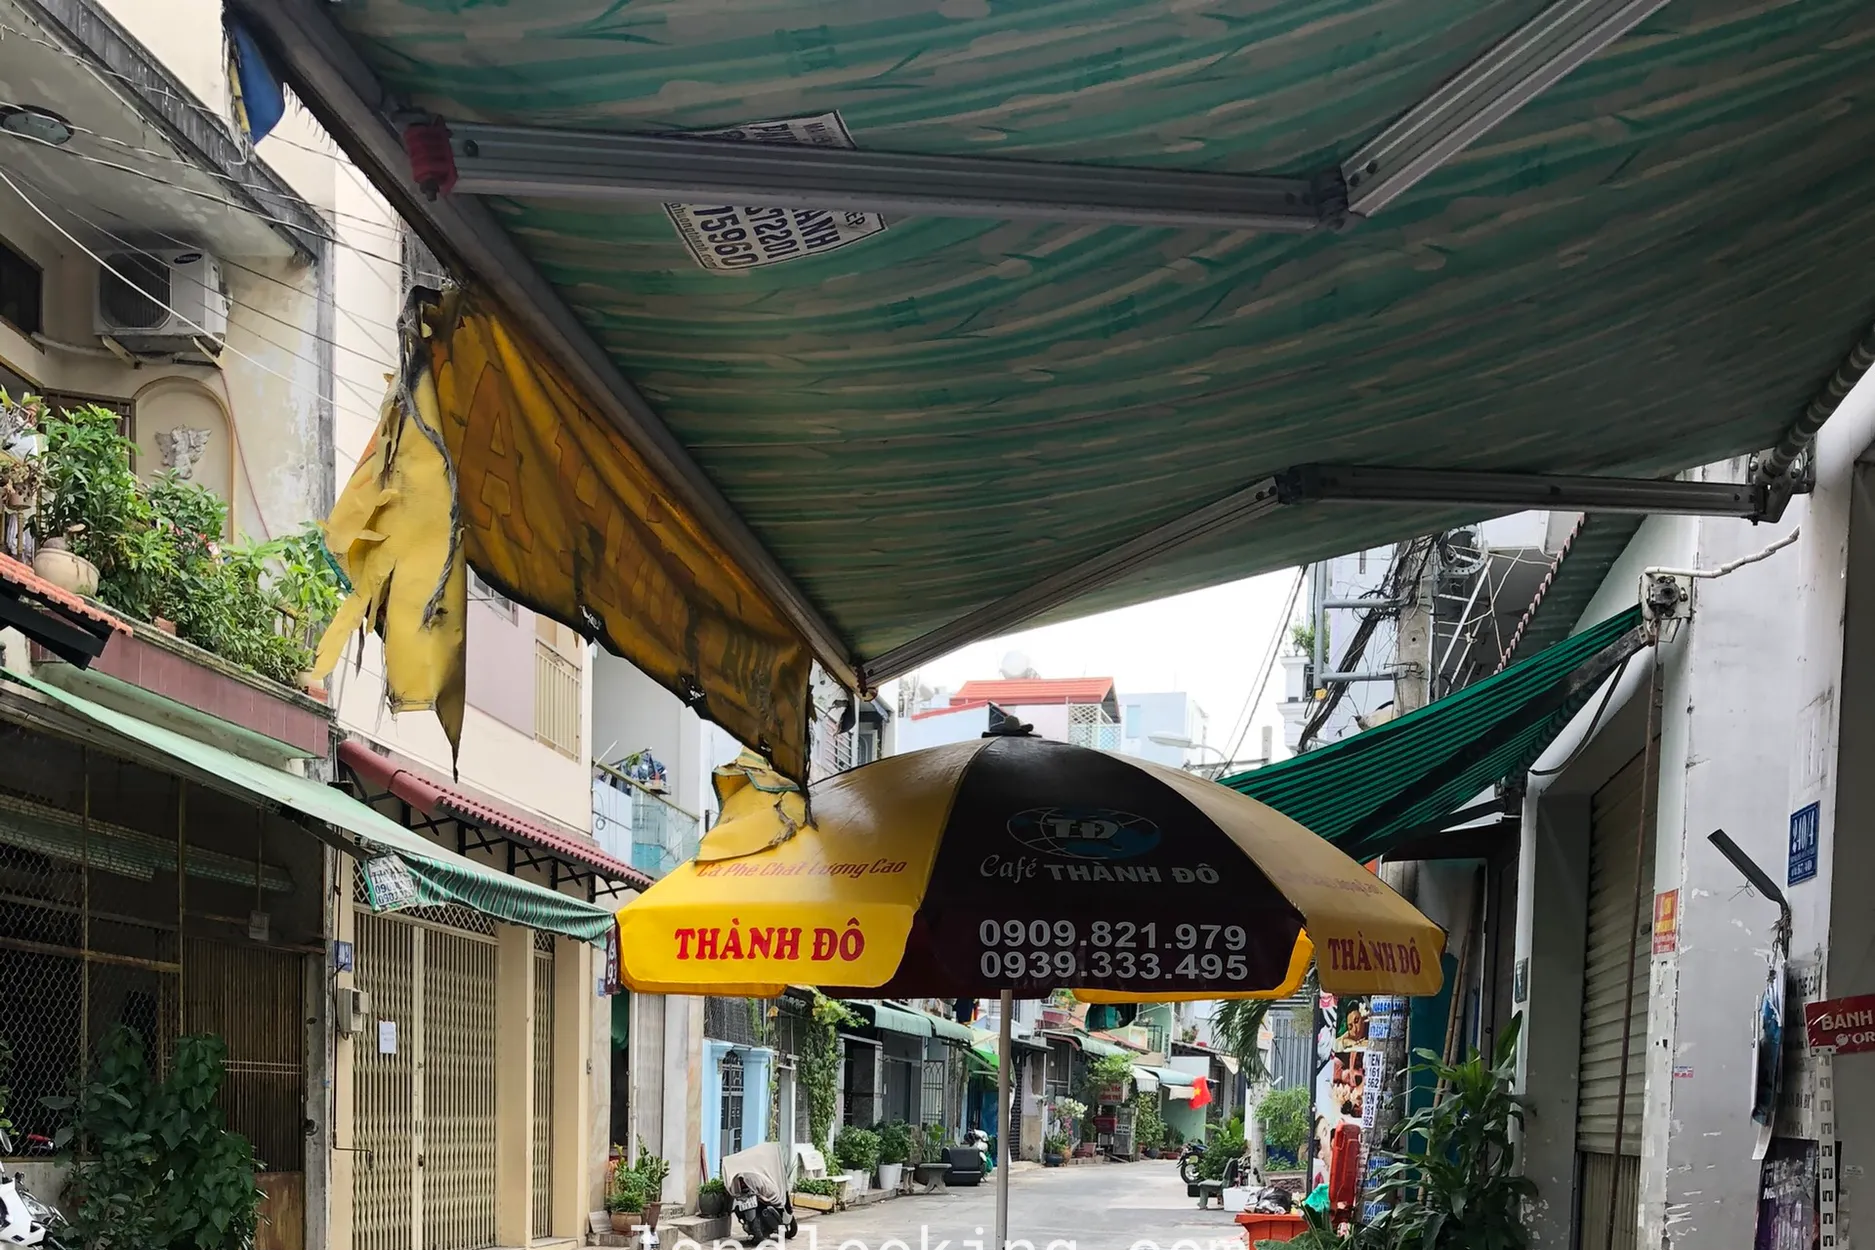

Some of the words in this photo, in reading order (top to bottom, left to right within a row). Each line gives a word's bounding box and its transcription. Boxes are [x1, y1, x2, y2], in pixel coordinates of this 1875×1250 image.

[791, 206, 841, 250] ANH
[868, 857, 908, 875] Cao
[979, 854, 1037, 884] Café
[1043, 862, 1162, 884] THÀNH
[1171, 863, 1221, 885] ĐÔ
[674, 917, 803, 961] THÀNH
[811, 916, 866, 962] ĐÔ
[979, 919, 1247, 952] 0909.821.979
[980, 951, 1249, 981] 0939.333.495
[1327, 931, 1397, 974] THÀNH
[1398, 937, 1422, 976] ĐÔ
[1820, 1008, 1874, 1031] BÁNH
